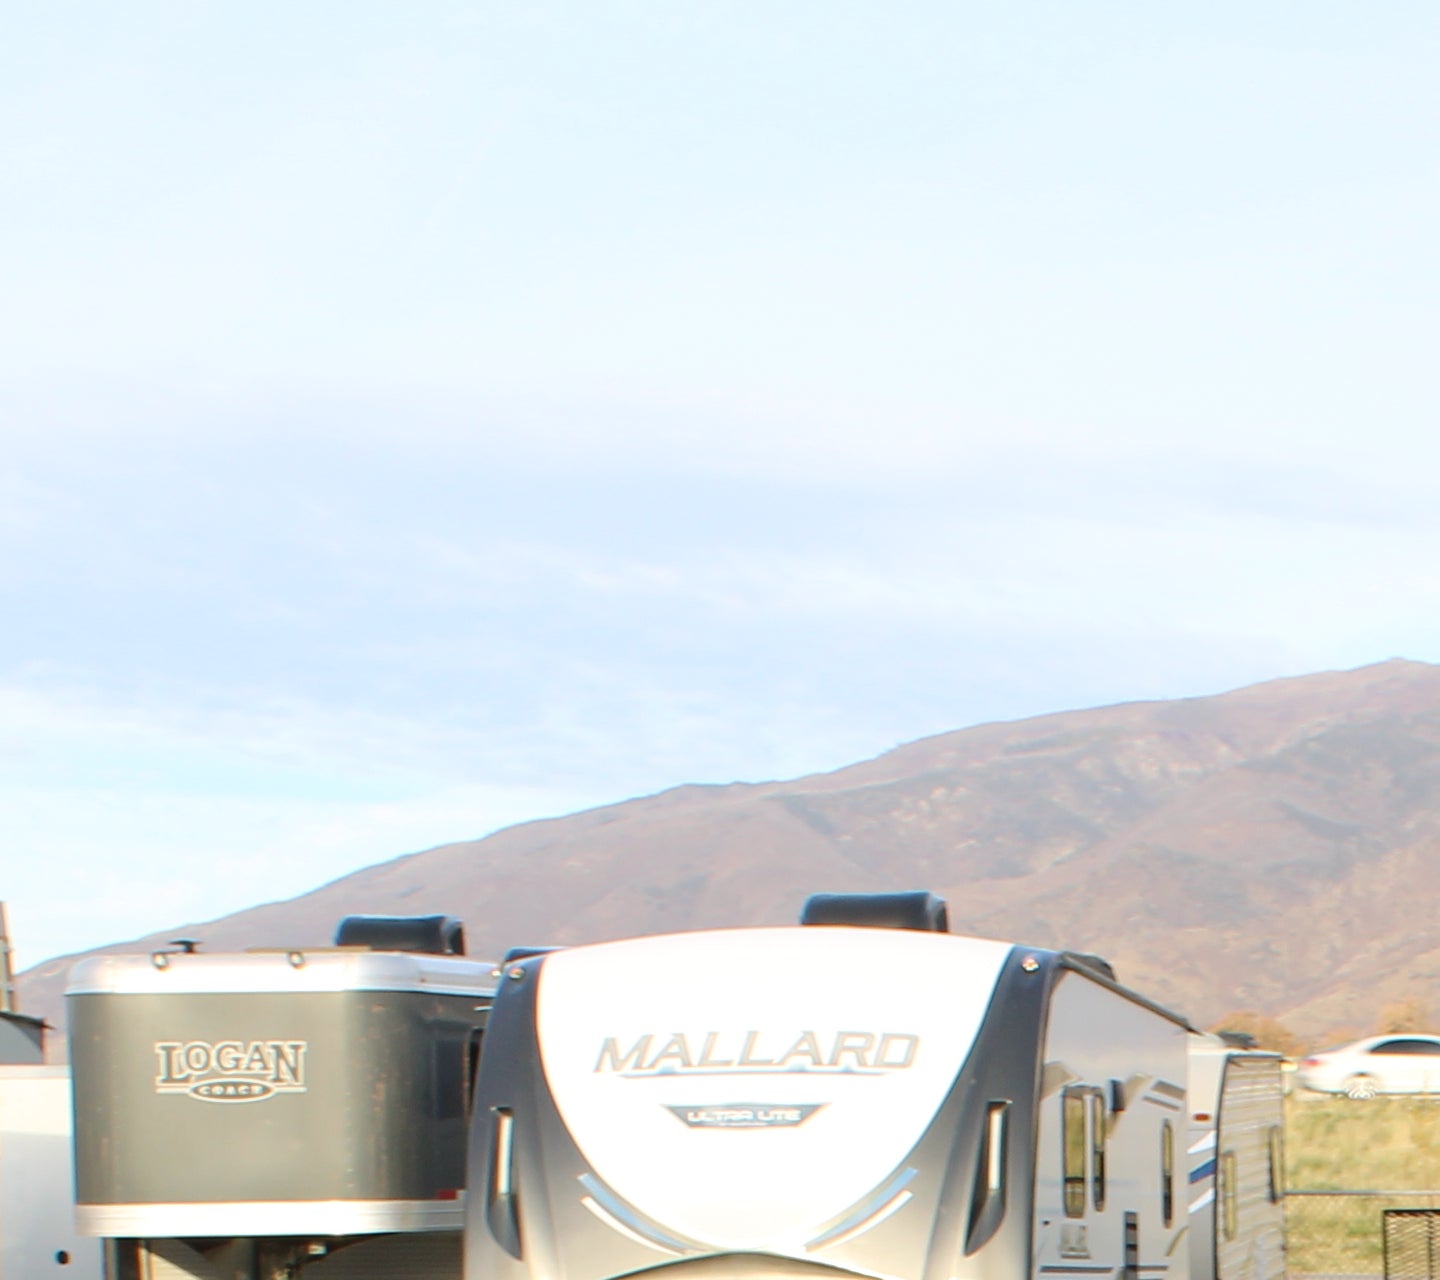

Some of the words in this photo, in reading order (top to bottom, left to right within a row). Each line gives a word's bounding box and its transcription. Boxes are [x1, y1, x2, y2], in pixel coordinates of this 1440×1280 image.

[154, 1040, 308, 1087] LOGAN
[593, 1030, 920, 1073] MALLARD
[198, 1085, 265, 1096] COACH
[687, 1108, 754, 1123] ULTRA
[758, 1108, 802, 1122] LITE
